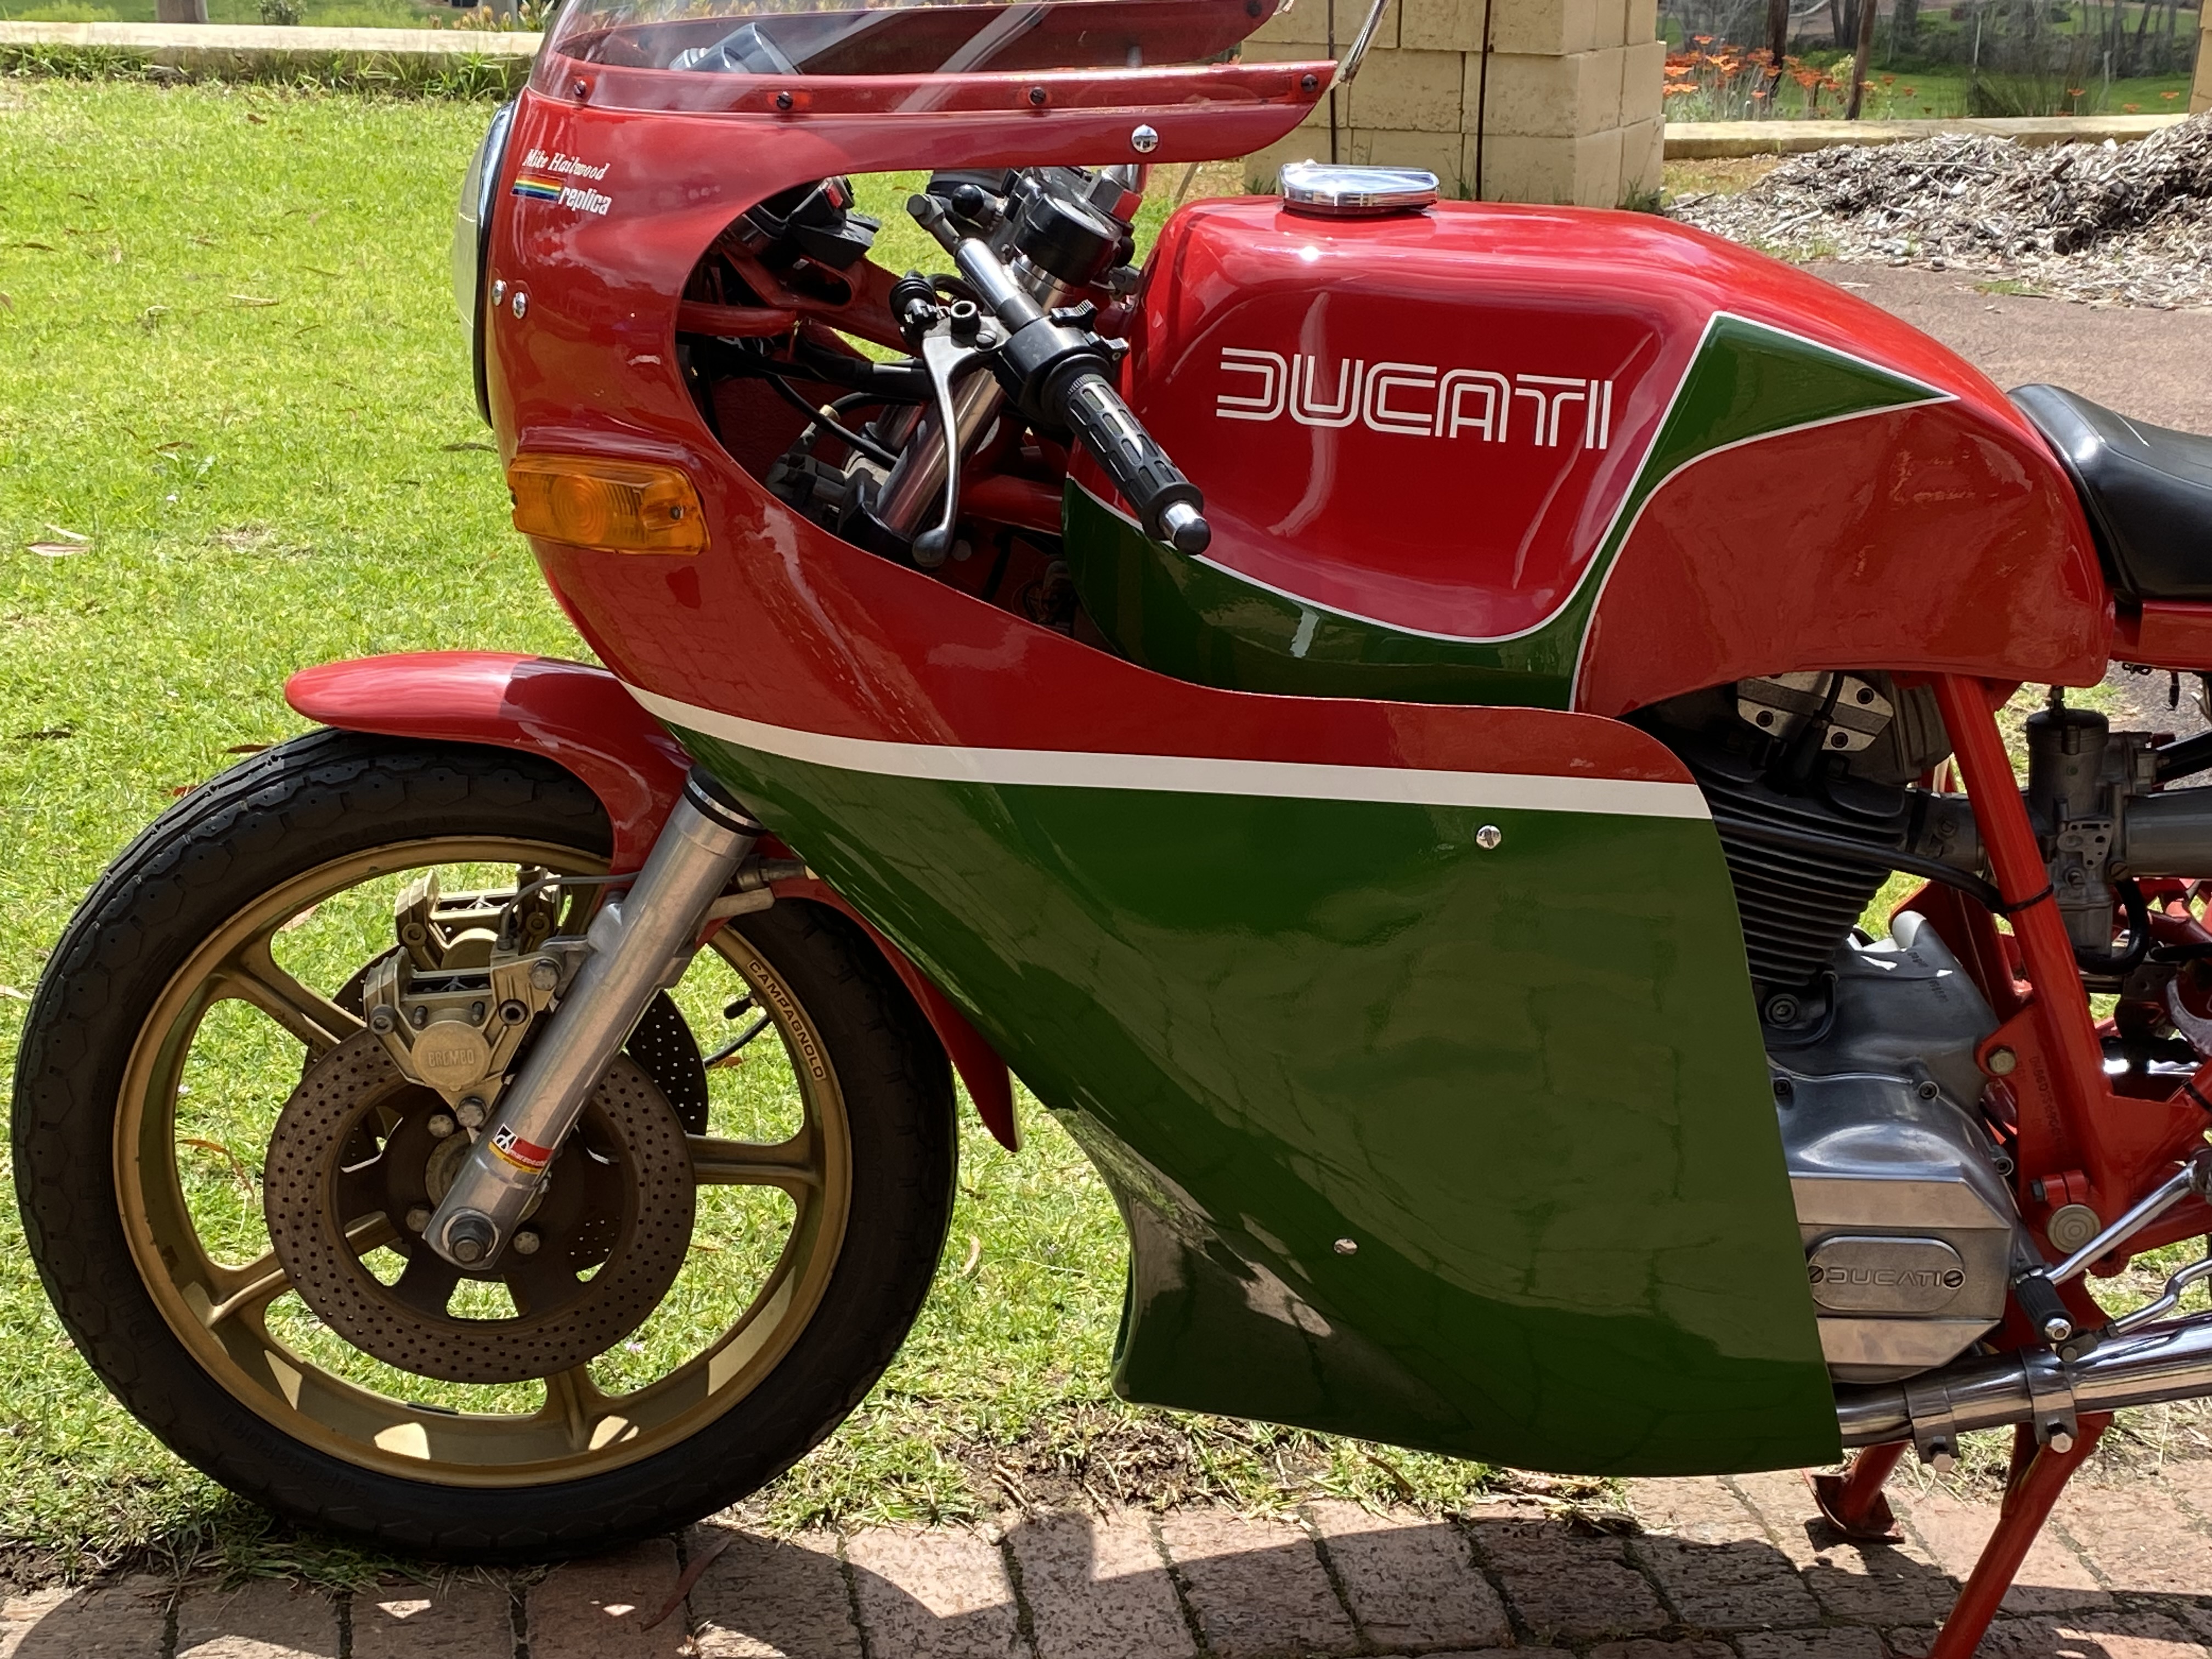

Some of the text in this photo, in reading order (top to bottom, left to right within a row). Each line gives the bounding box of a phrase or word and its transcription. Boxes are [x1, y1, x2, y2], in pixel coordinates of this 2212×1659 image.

[522, 149, 611, 181] Mike Hailwood
[558, 187, 612, 215] replica
[1216, 347, 1613, 449] DUCATI
[749, 962, 824, 1078] CAMPAGNOLO
[428, 1049, 475, 1067] BREMBO
[1826, 1266, 1942, 1286] DUCATI
